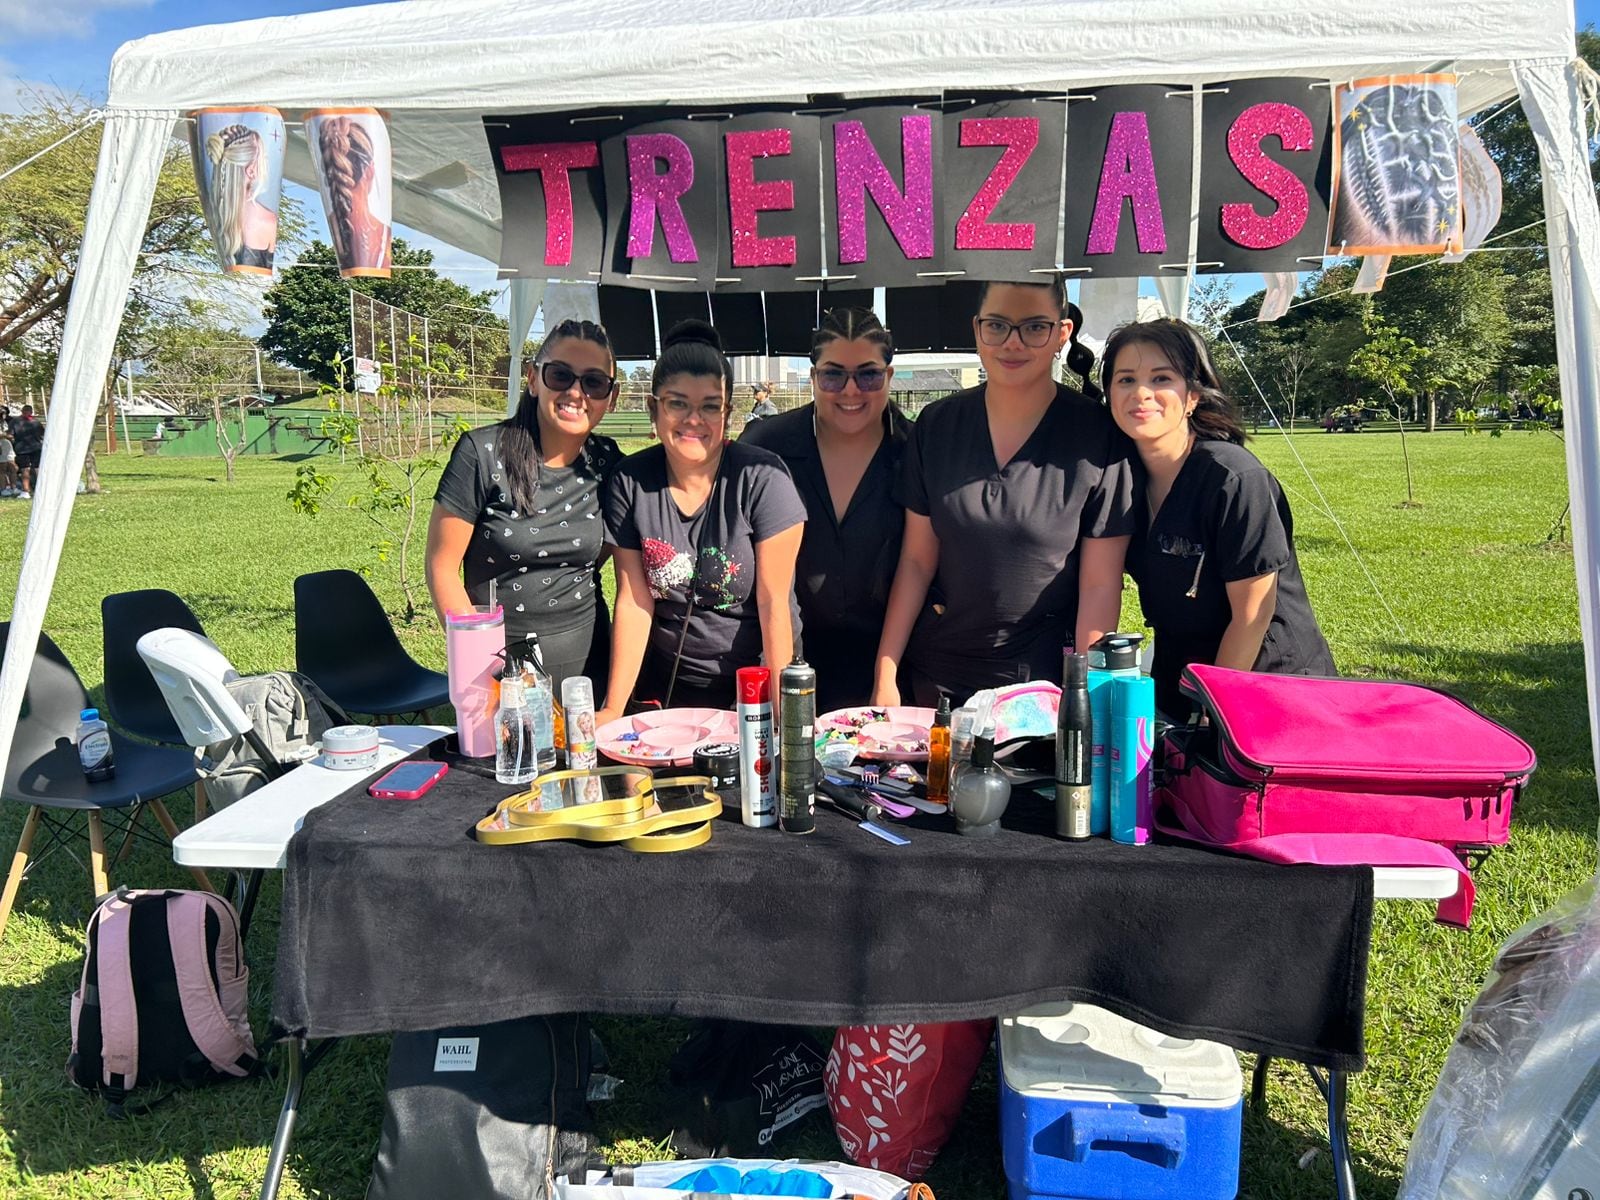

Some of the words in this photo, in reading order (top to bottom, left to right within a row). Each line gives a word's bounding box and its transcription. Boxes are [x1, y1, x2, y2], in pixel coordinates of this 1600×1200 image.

[500, 101, 1313, 268] TRENZAS
[754, 739, 771, 794] SHOCK
[442, 1045, 472, 1055] WAHL
